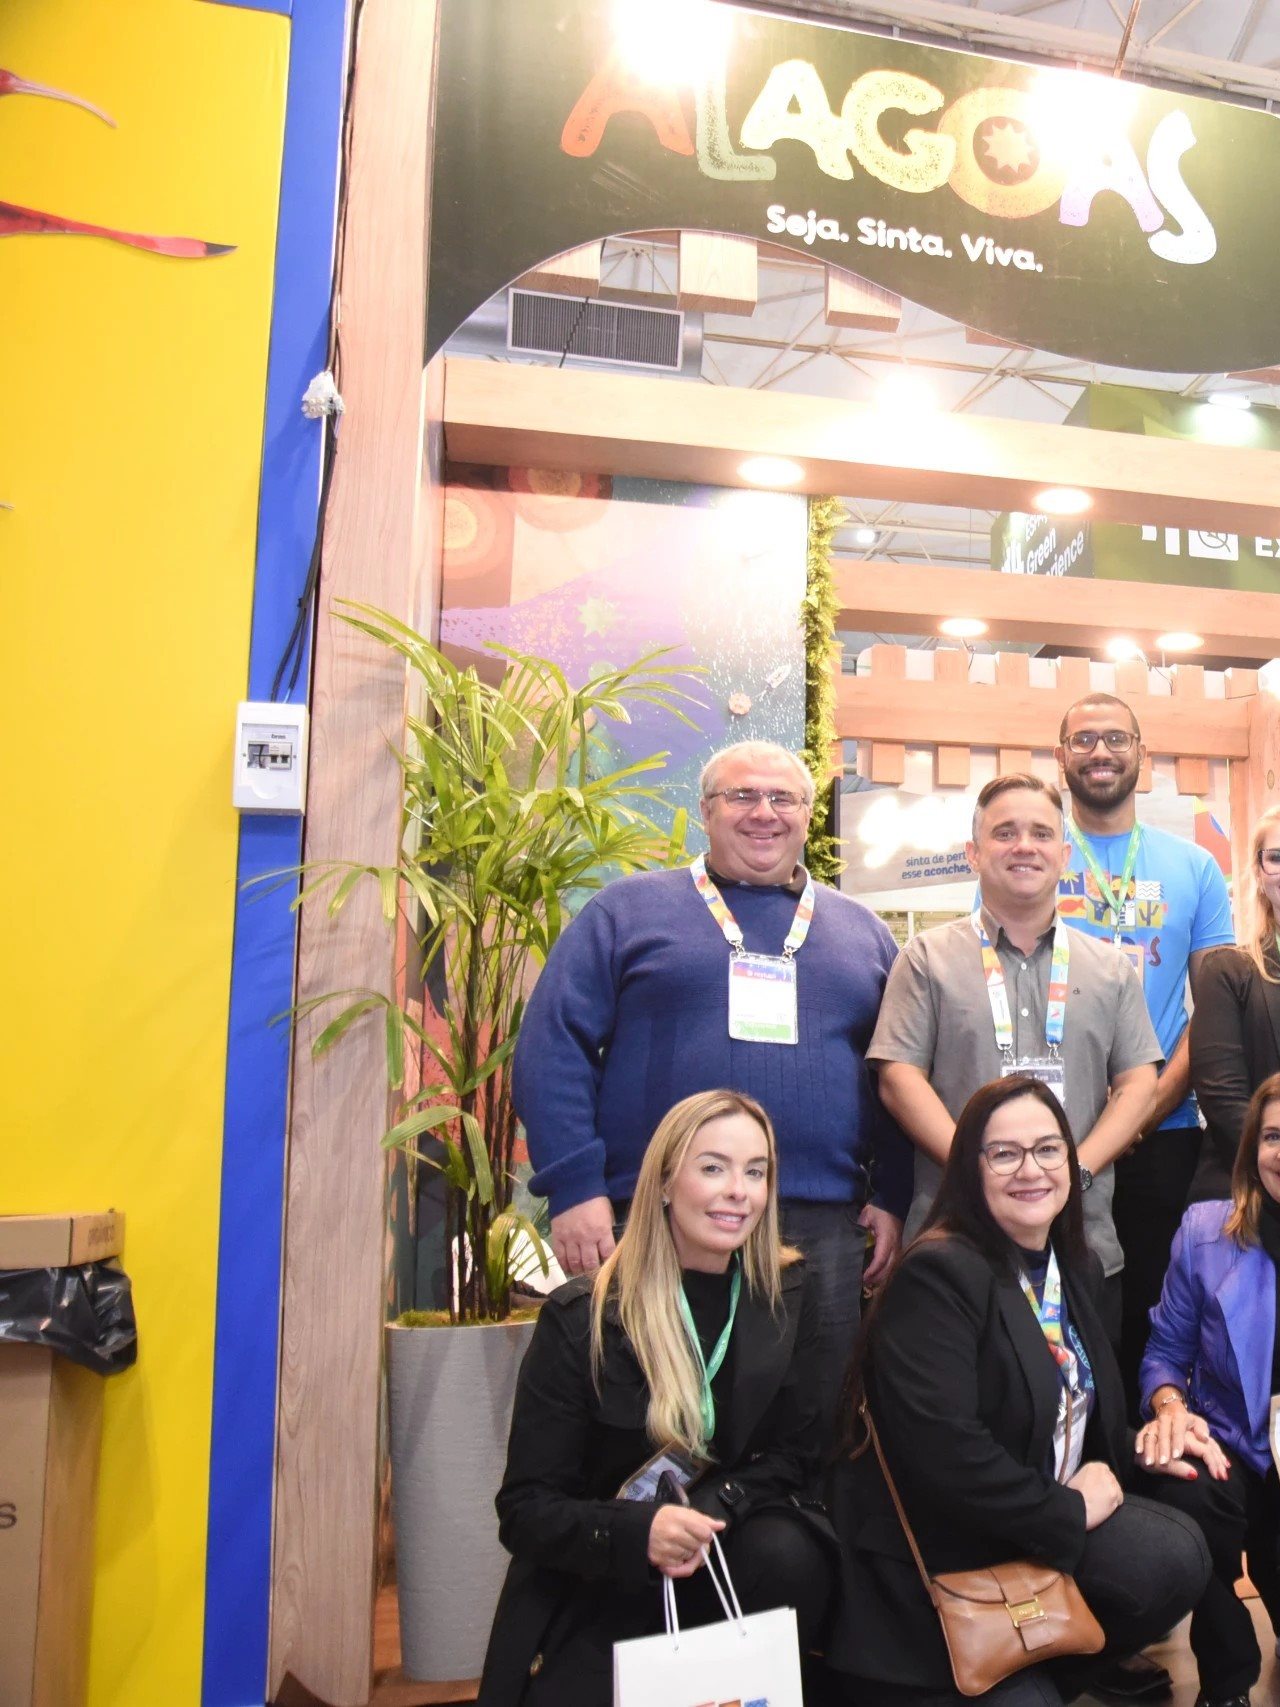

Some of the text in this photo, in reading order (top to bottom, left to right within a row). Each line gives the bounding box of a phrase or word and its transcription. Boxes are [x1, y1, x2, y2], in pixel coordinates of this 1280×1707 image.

[560, 20, 1217, 264] ALAGOAS
[766, 204, 1043, 272] Seja. Sinta. Viva.
[1026, 527, 1057, 574] Green
[901, 868, 922, 880] esse
[905, 851, 967, 867] sinta de pert
